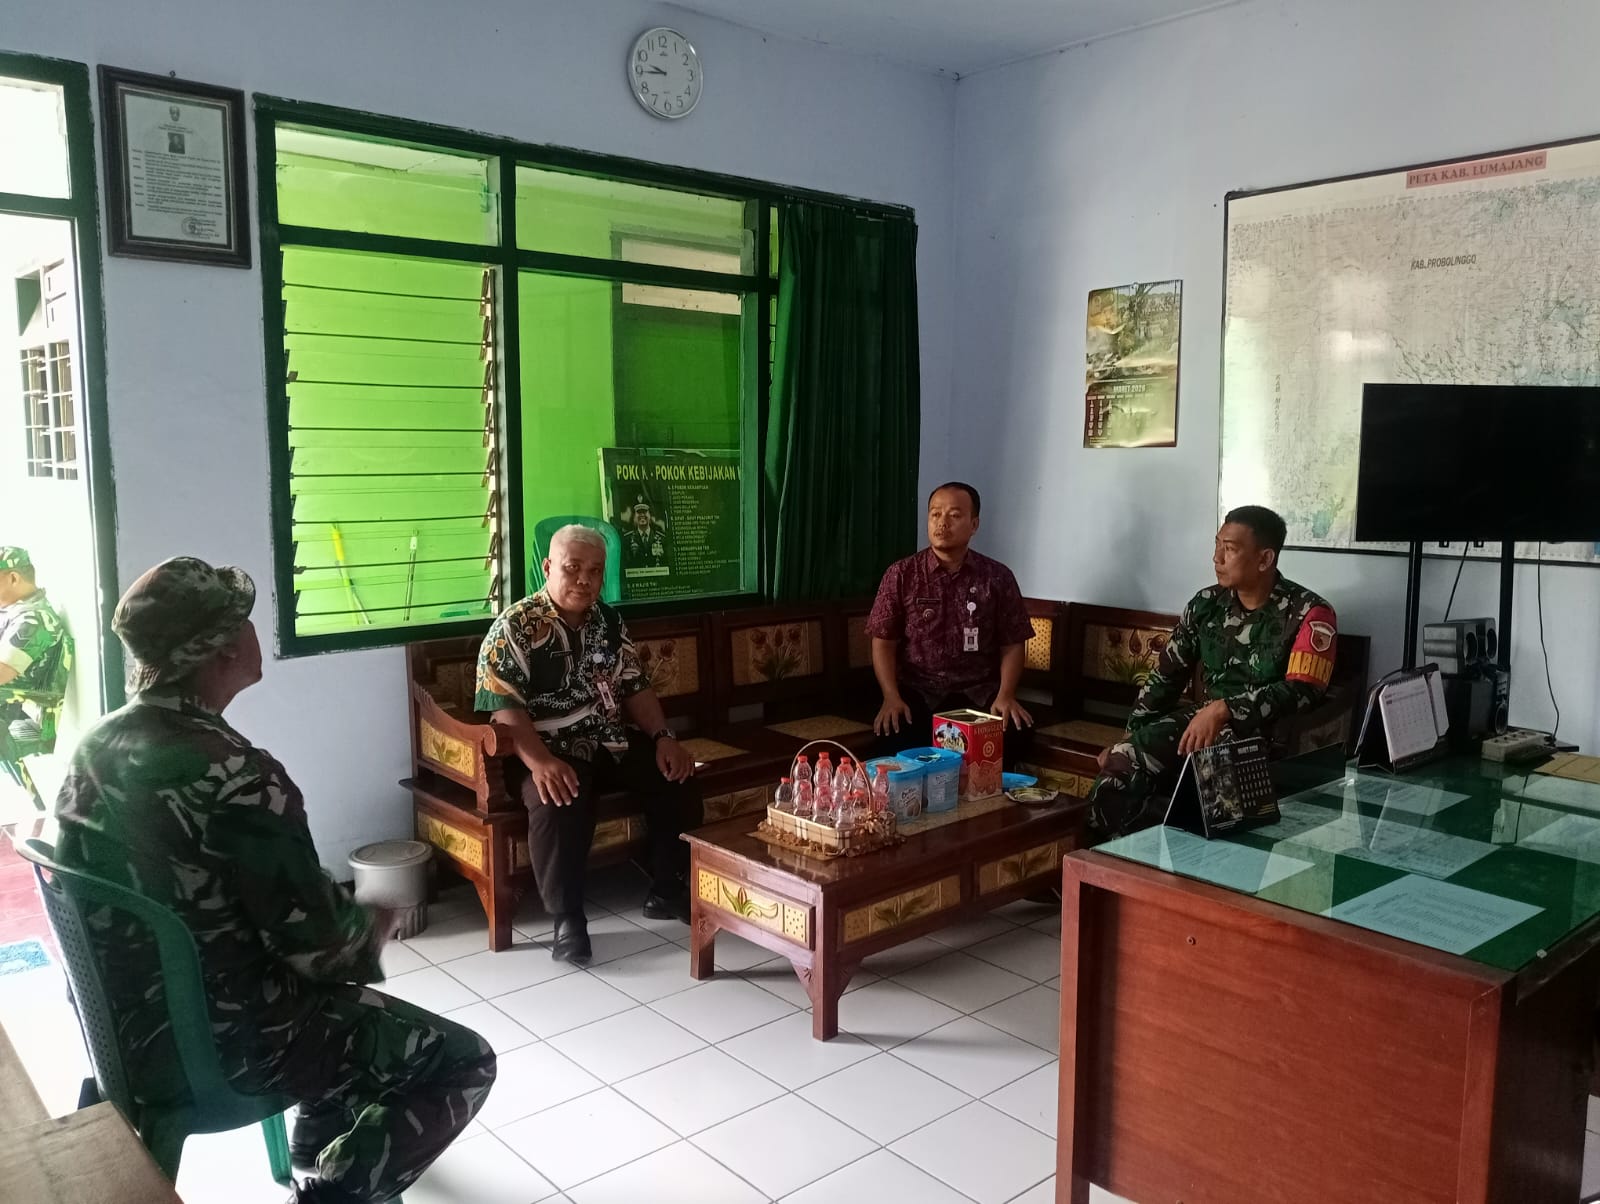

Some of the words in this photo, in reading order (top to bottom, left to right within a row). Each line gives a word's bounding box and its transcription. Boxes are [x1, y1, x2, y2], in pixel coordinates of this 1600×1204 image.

[647, 39, 654, 52] 11
[657, 35, 668, 49] 12
[673, 41, 678, 54] 1
[637, 48, 648, 62] 10
[681, 53, 689, 66] 2
[635, 65, 643, 76] 9
[687, 69, 694, 82] 3
[641, 81, 649, 94] 8
[684, 84, 691, 97] 4
[651, 93, 659, 106] 7
[664, 99, 672, 112] 6
[676, 95, 683, 108] 5
[1409, 173, 1438, 185] PETA
[1441, 168, 1470, 181] KAB.
[1473, 156, 1544, 176] LUMAJANG
[655, 465, 687, 481] POKOK
[687, 465, 736, 481] KEBIJAKAN
